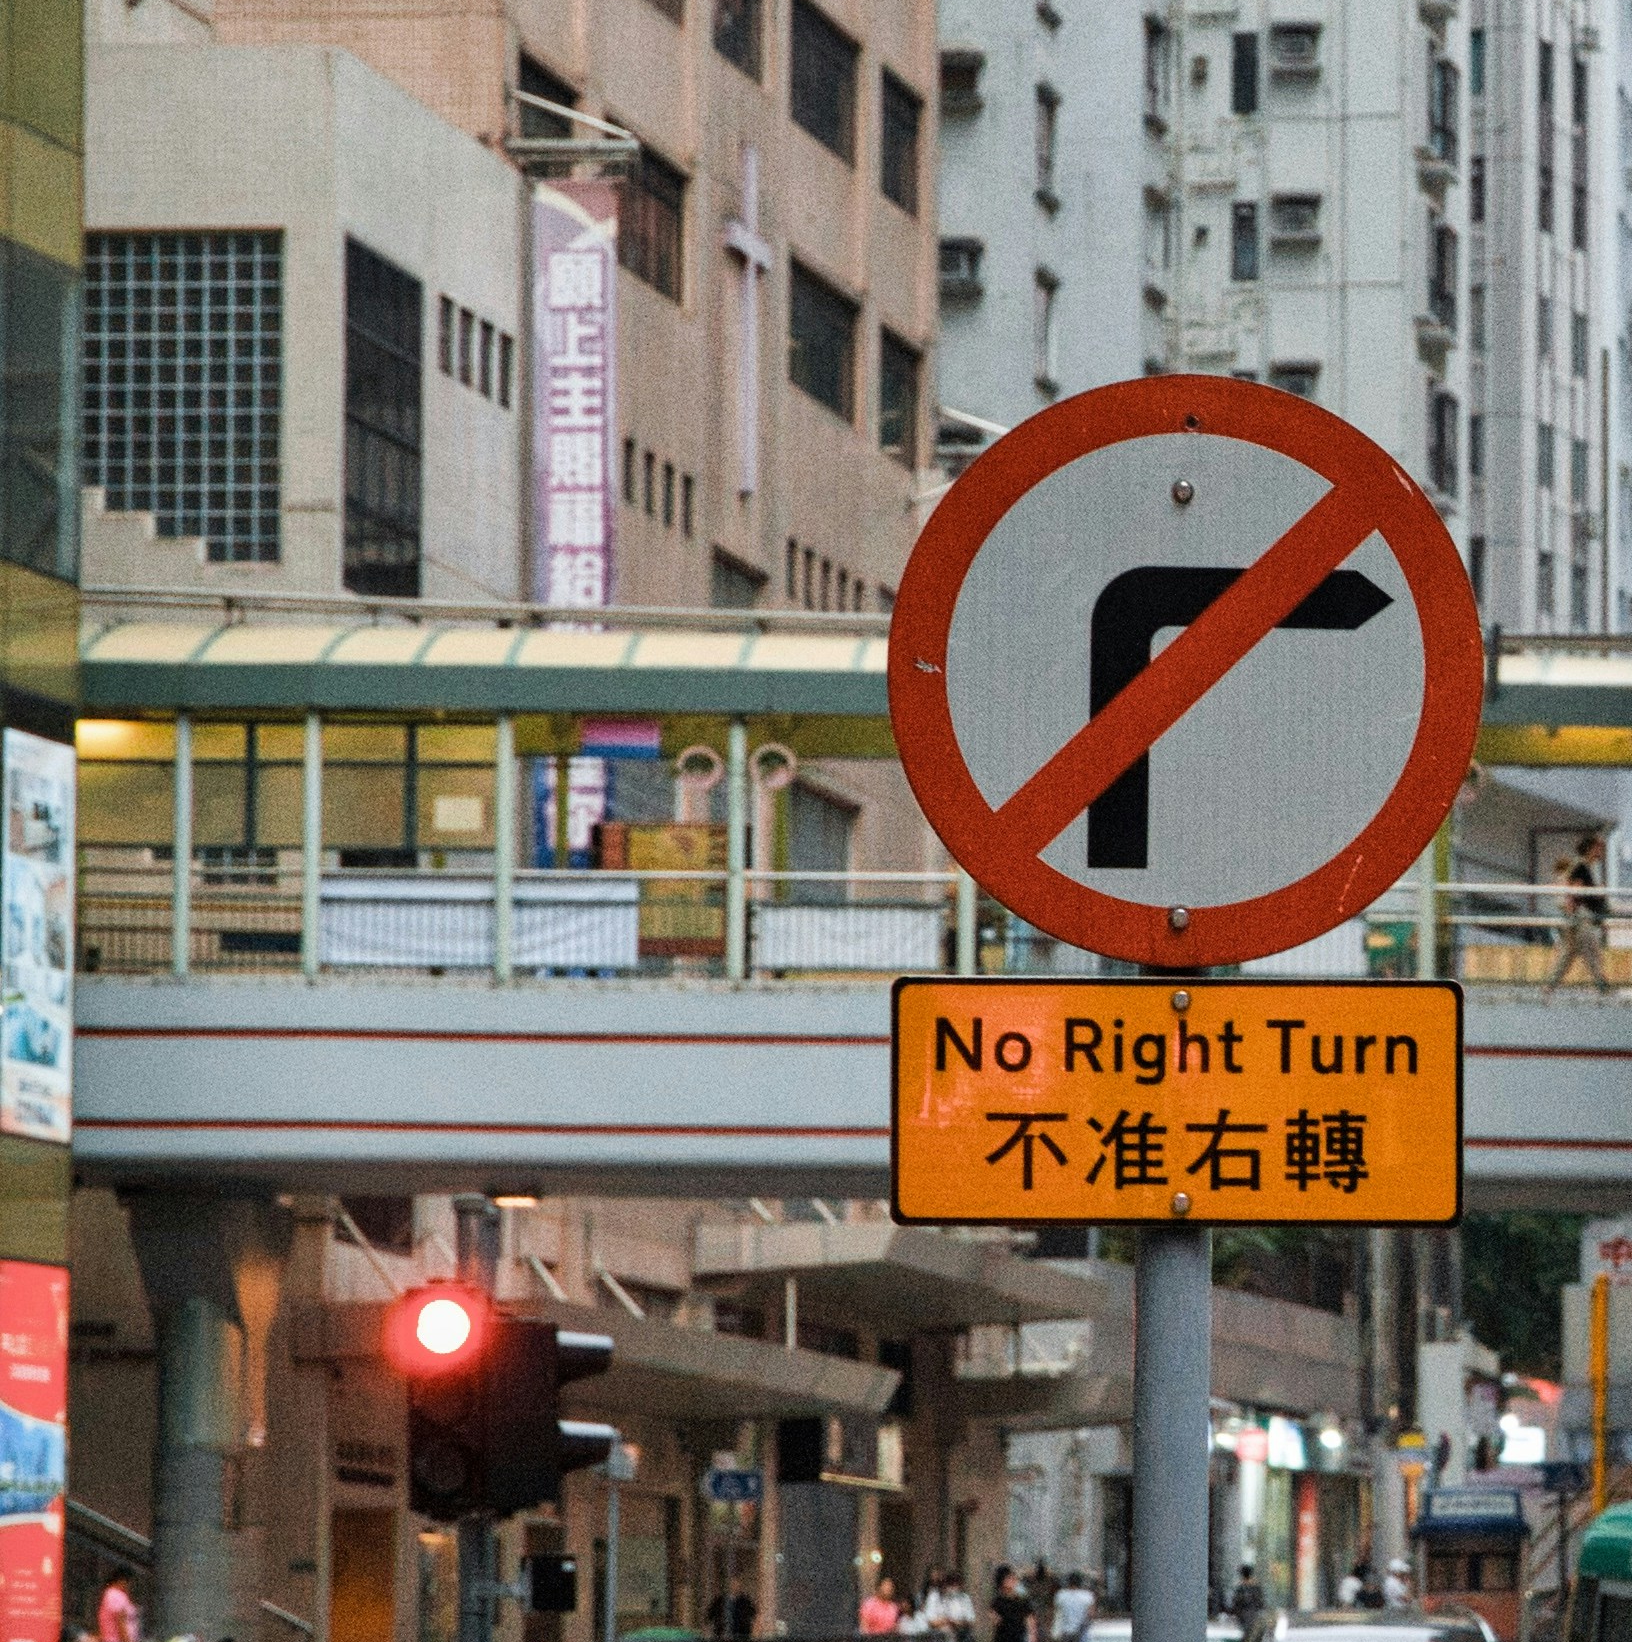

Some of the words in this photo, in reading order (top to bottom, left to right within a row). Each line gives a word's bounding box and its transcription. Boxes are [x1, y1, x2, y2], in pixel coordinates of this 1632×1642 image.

[548, 252, 604, 631] 願上主賜福給
[935, 1016, 1032, 1073] No
[1064, 1017, 1243, 1085] Right
[1266, 1019, 1418, 1075] Turn
[985, 1109, 1369, 1193] 不准右轉
